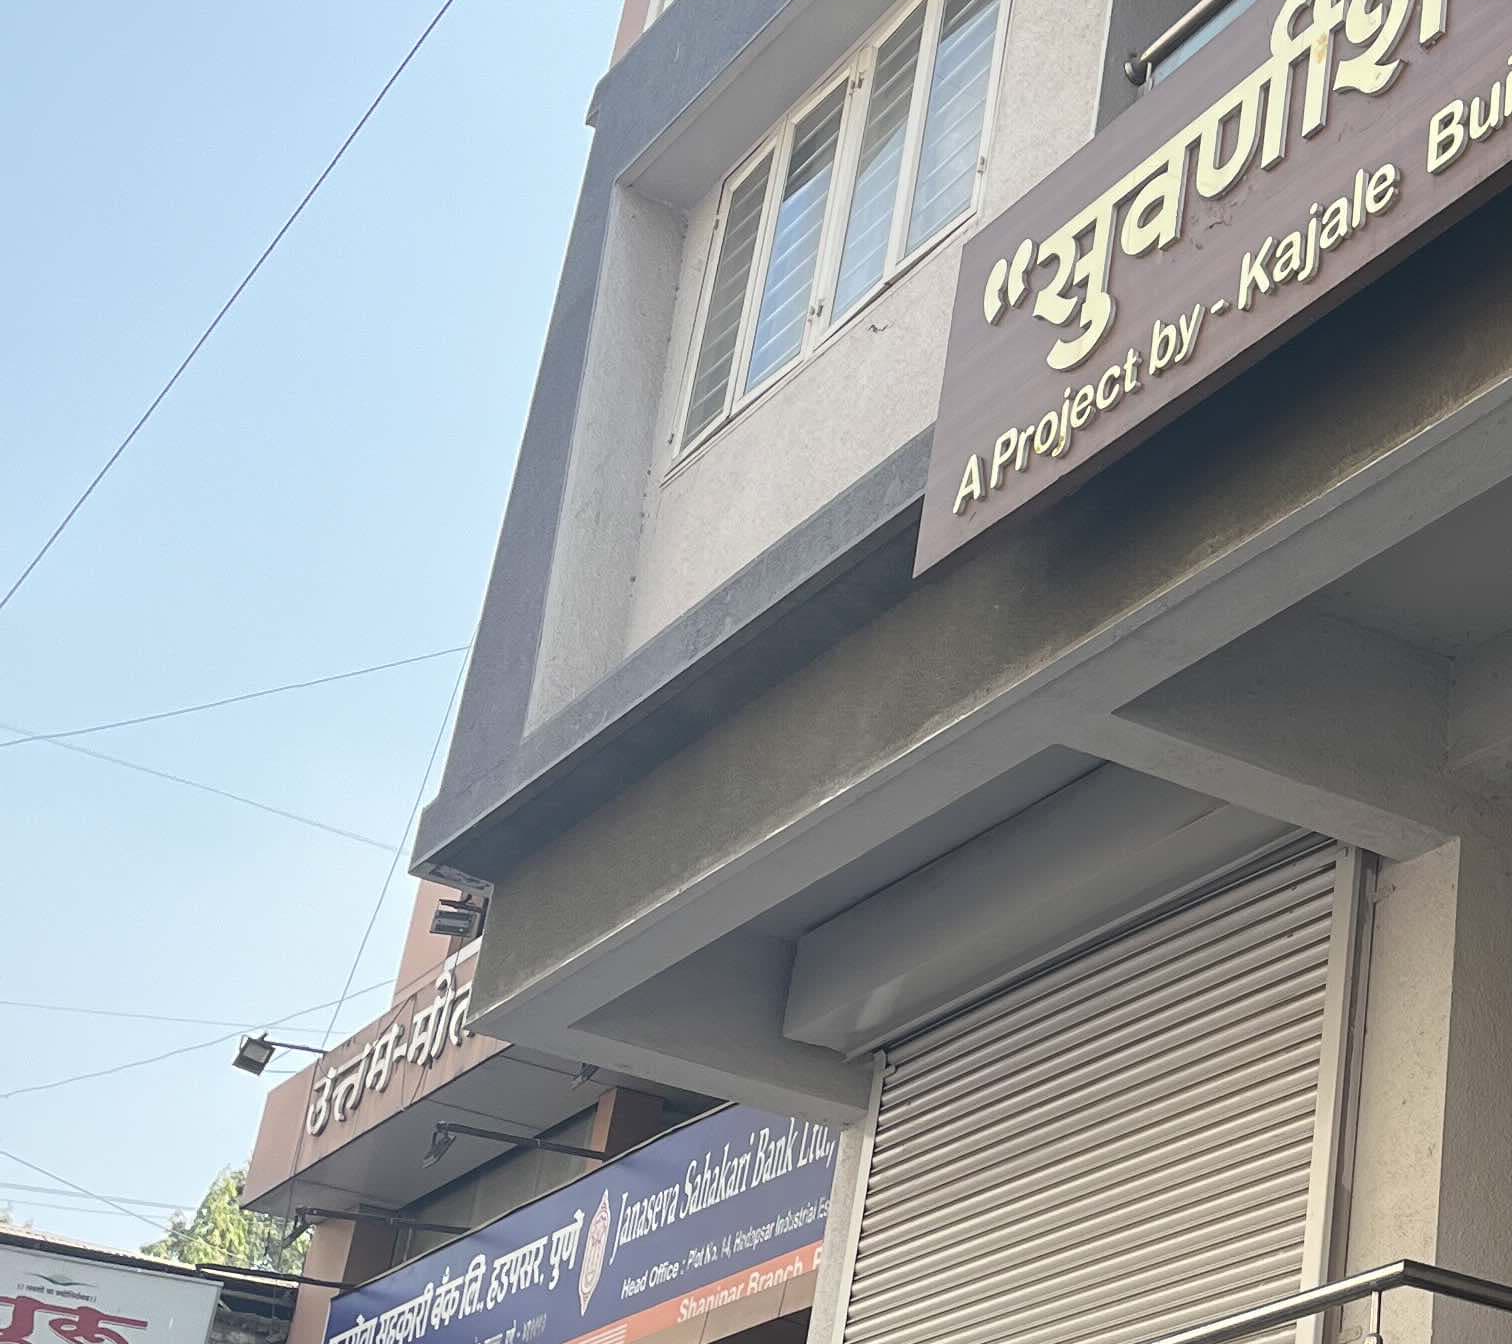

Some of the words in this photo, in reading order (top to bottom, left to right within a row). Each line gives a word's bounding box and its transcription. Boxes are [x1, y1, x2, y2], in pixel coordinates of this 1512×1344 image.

[951, 451, 990, 516] A
[988, 352, 1142, 494] Project
[1236, 163, 1399, 314] Kajale
[609, 1183, 680, 1266] Janaseva
[680, 1132, 754, 1219] Sahakari
[751, 1116, 799, 1188] Bank
[548, 1209, 584, 1290] पुणे
[620, 1267, 648, 1299] Head
[649, 1261, 679, 1287] Office
